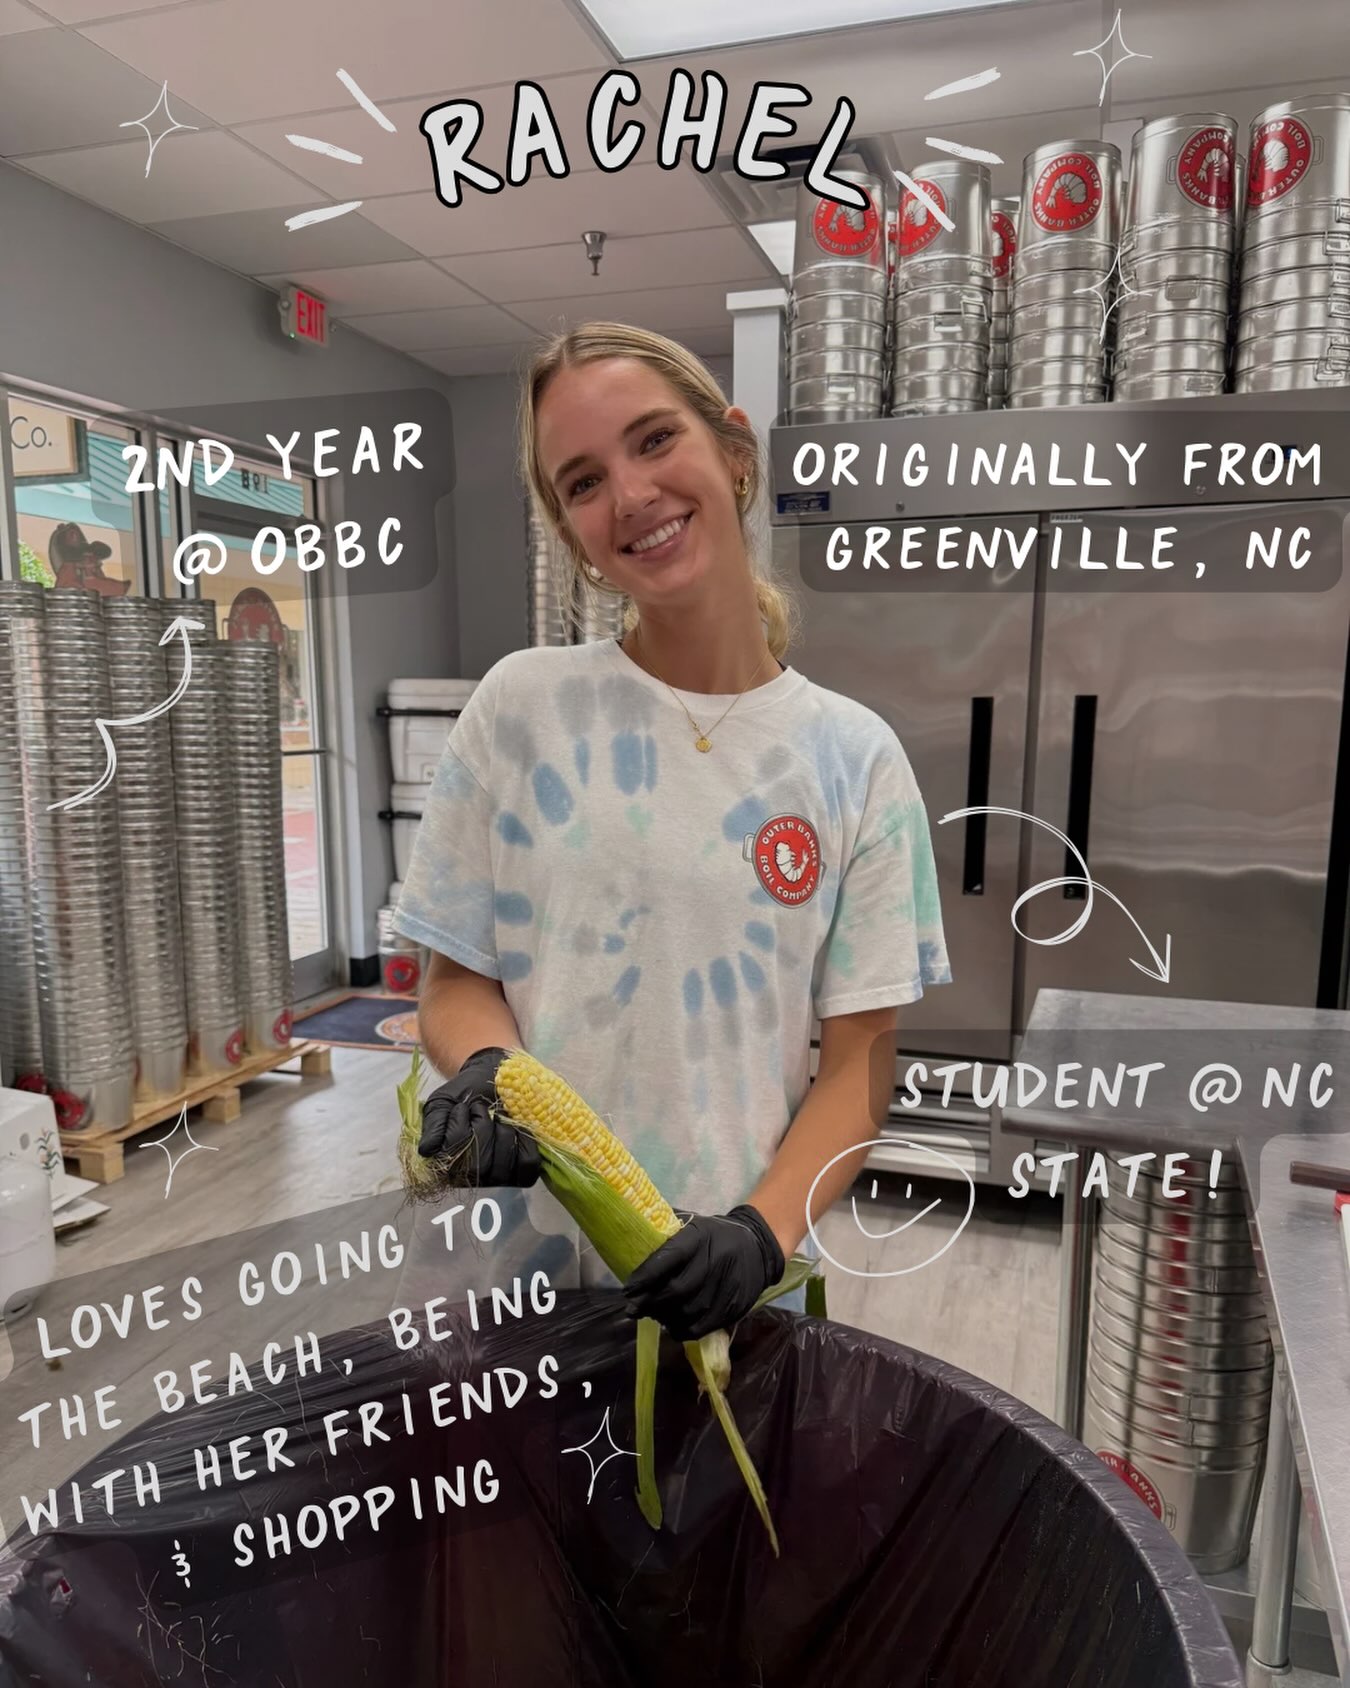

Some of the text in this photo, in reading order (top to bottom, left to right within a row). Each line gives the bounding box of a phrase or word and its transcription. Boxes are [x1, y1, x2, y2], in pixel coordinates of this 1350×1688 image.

[1287, 123, 1306, 149] BOIL
[1035, 157, 1082, 196] COMPANY
[1183, 172, 1216, 205] BANKS
[1268, 159, 1305, 196] OUTER
[1068, 198, 1100, 225] OUTER
[296, 290, 326, 344] EXIT
[10, 416, 53, 449] Co.
[761, 821, 818, 867] OUTER BANKS
[760, 855, 815, 900] BOIL COMPANY
